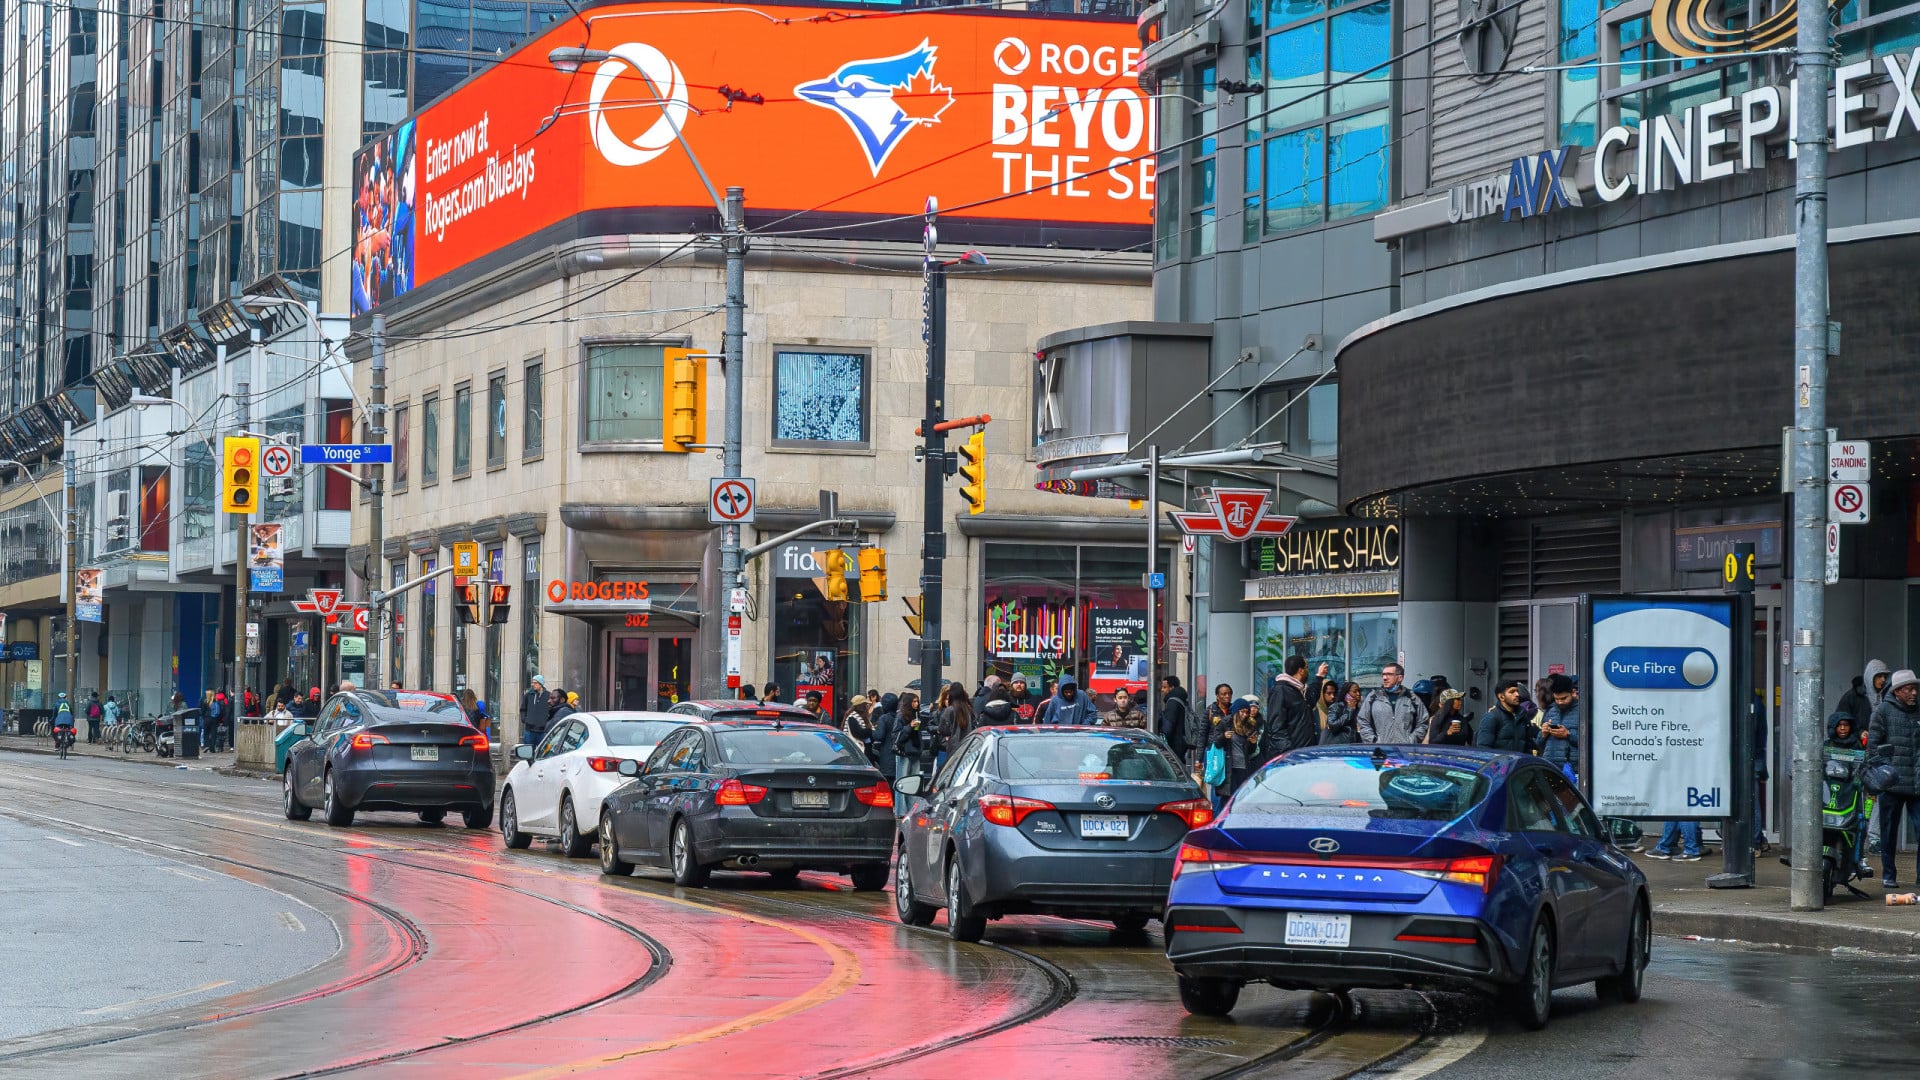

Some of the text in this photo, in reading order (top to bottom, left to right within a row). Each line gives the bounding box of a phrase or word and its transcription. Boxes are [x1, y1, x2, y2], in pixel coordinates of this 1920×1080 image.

[992, 83, 1155, 153] BEYO
[425, 111, 489, 183] Enter now at
[992, 151, 1091, 198] THE
[1448, 145, 1570, 224] ULTRA AVX
[425, 144, 535, 243] Rogers.com/BlueJays
[322, 446, 371, 464] Yonge St
[1842, 445, 1855, 455] NO
[1831, 457, 1867, 468] STANDING
[1277, 524, 1399, 572] SHAKE SHAC
[784, 546, 822, 570] fid
[571, 581, 649, 600] ROGERS
[1259, 577, 1300, 598] BURGERS
[625, 613, 649, 627] 302
[1096, 616, 1145, 628] It's saving
[1096, 627, 1132, 635] season.
[997, 634, 1063, 650] SPRING
[1611, 661, 1676, 674] Pure Fibre
[1612, 705, 1665, 716] Switch on
[1612, 721, 1691, 733] Bell Pure Fibre,
[1611, 735, 1662, 747] Canada's
[1611, 751, 1658, 762] Internet.
[1687, 787, 1721, 808] Bell
[1083, 820, 1127, 831] DDCX 027
[1262, 870, 1383, 882] ELANTRA
[1289, 920, 1347, 939] DDRN 017
